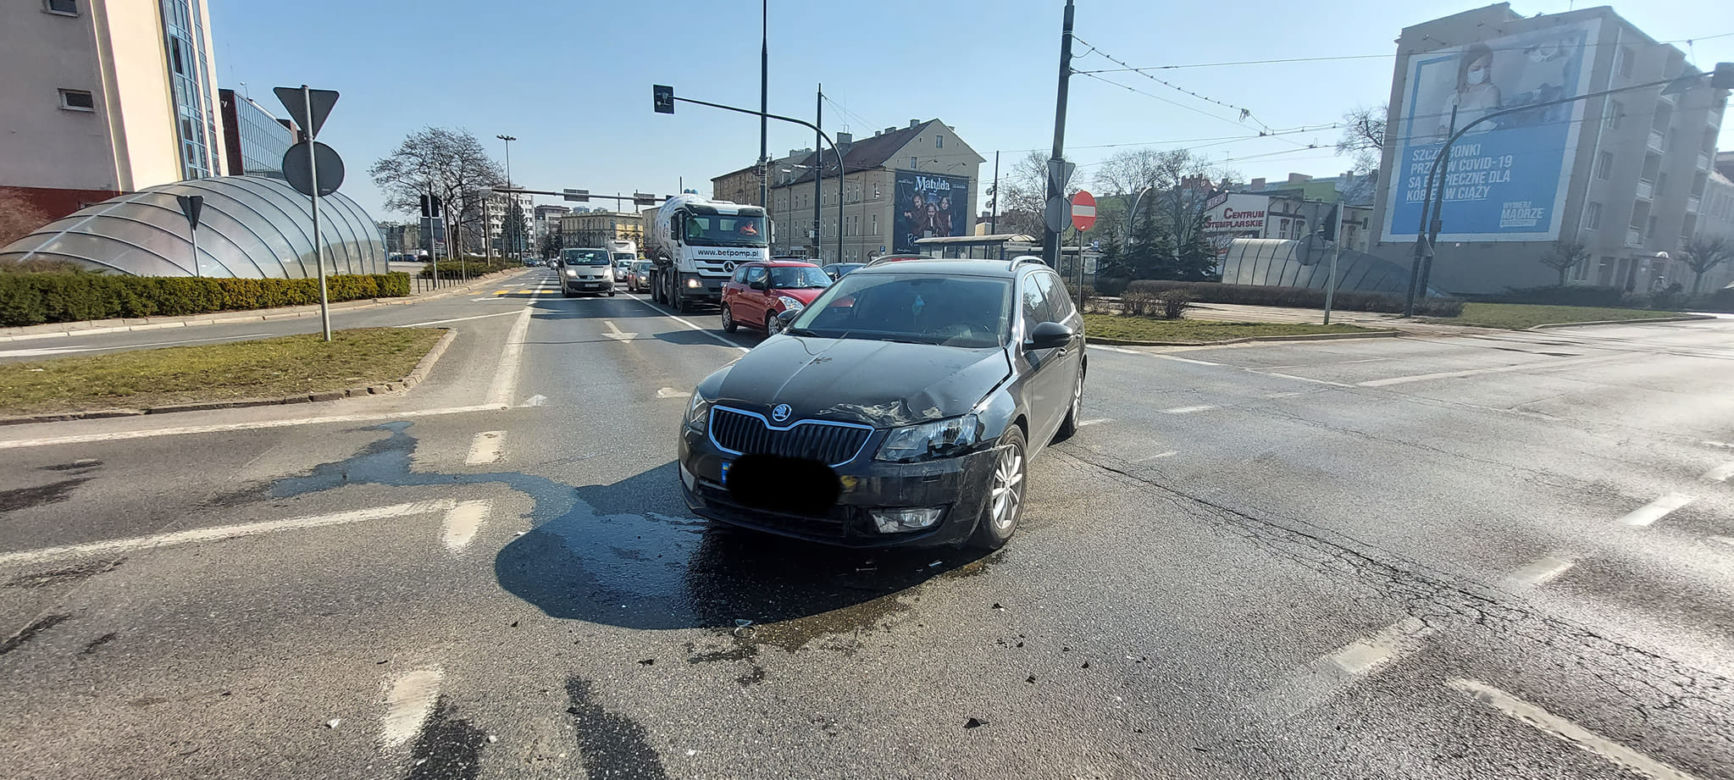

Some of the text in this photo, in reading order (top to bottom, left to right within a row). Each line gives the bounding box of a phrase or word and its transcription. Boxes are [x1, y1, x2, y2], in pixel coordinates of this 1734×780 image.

[1412, 144, 1481, 161] SZCZIONKI
[1410, 155, 1513, 175] PRZCW COVID-19
[914, 176, 950, 193] Matylda
[1408, 176, 1421, 190] SĄ
[1488, 169, 1511, 183] DLA
[1406, 188, 1441, 201] KOBE
[1445, 187, 1457, 200] W
[1223, 207, 1265, 219] CENTRUM
[697, 249, 759, 258] www.betpomp.pl
